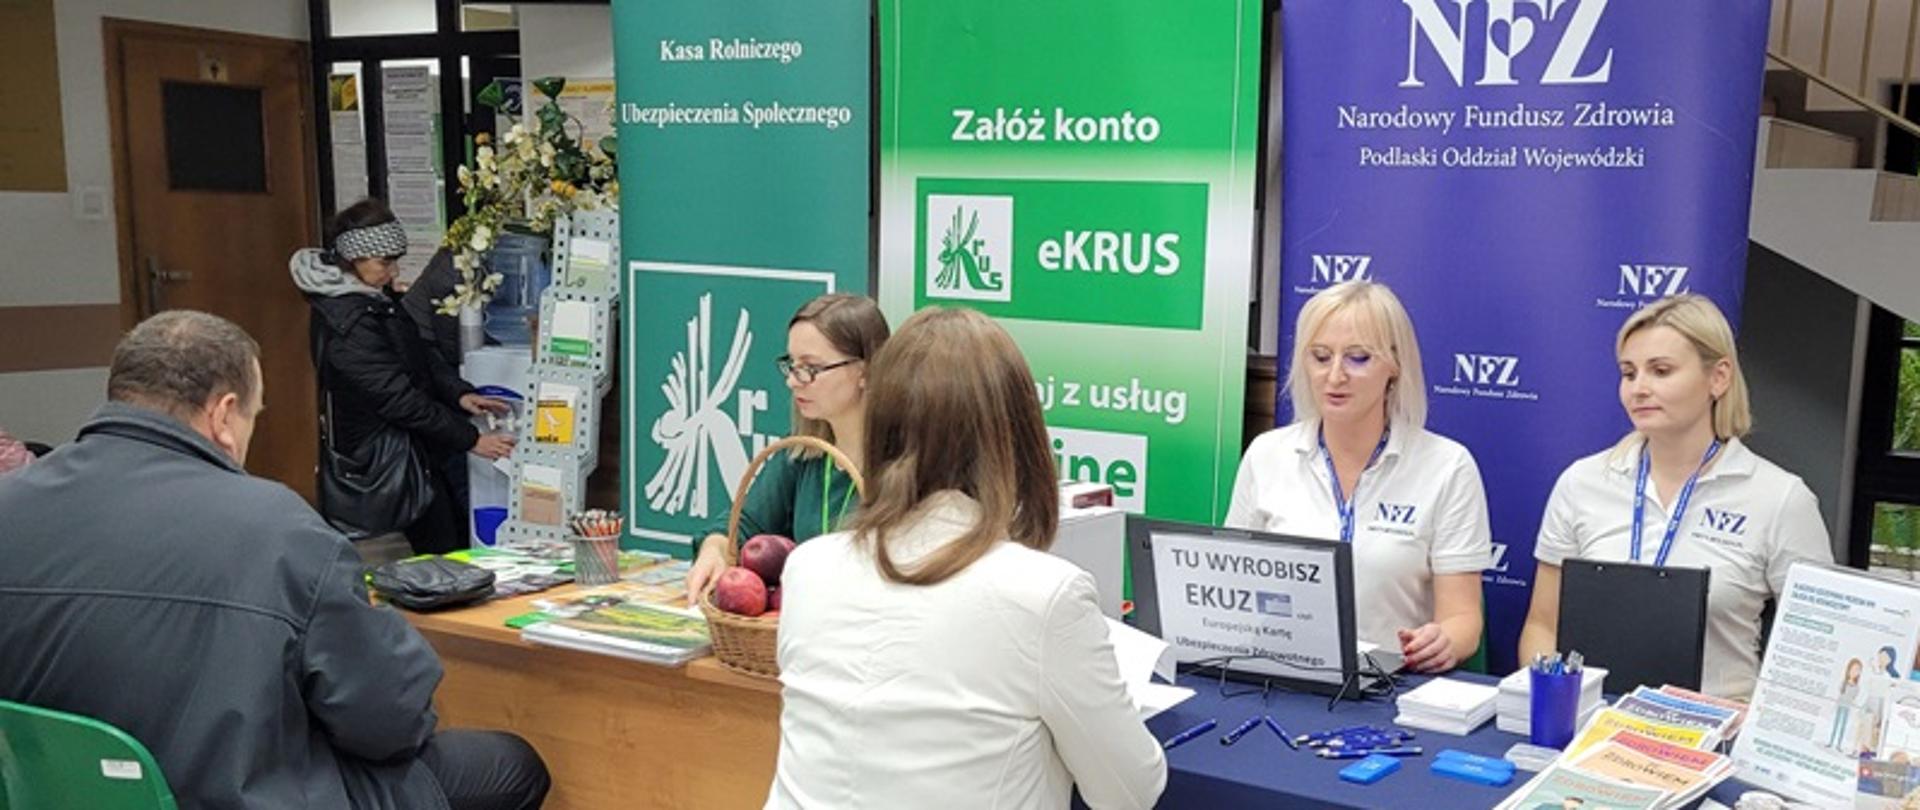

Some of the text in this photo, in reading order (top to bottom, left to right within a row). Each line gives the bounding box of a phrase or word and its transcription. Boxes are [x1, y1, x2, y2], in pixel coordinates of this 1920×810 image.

[660, 38, 802, 63] Kasa Rolniczego
[1398, 0, 1614, 88] NFZ
[621, 102, 739, 129] Ubezpieczenia
[951, 107, 1161, 142] Załóż konto
[1337, 102, 1674, 134] Narodowy Fundusz Zdrowia
[1359, 146, 1645, 172] Podlaski Oddział Wojewódzki
[1037, 230, 1181, 276] eKRUS
[1311, 255, 1373, 285] NFZ
[1618, 264, 1690, 297] NFZ
[1453, 353, 1520, 387] NFZ
[1061, 381, 1081, 406] z
[1089, 378, 1188, 424] usług
[1376, 502, 1416, 525] NFZ
[1699, 508, 1748, 535] NFZ
[1172, 549, 1321, 584] TU WYROBISZ
[1185, 583, 1253, 613] EKUZ
[1202, 617, 1293, 641] Europejską Kartę
[1176, 636, 1325, 667] Ubezpieczenia Zdrowotnego
